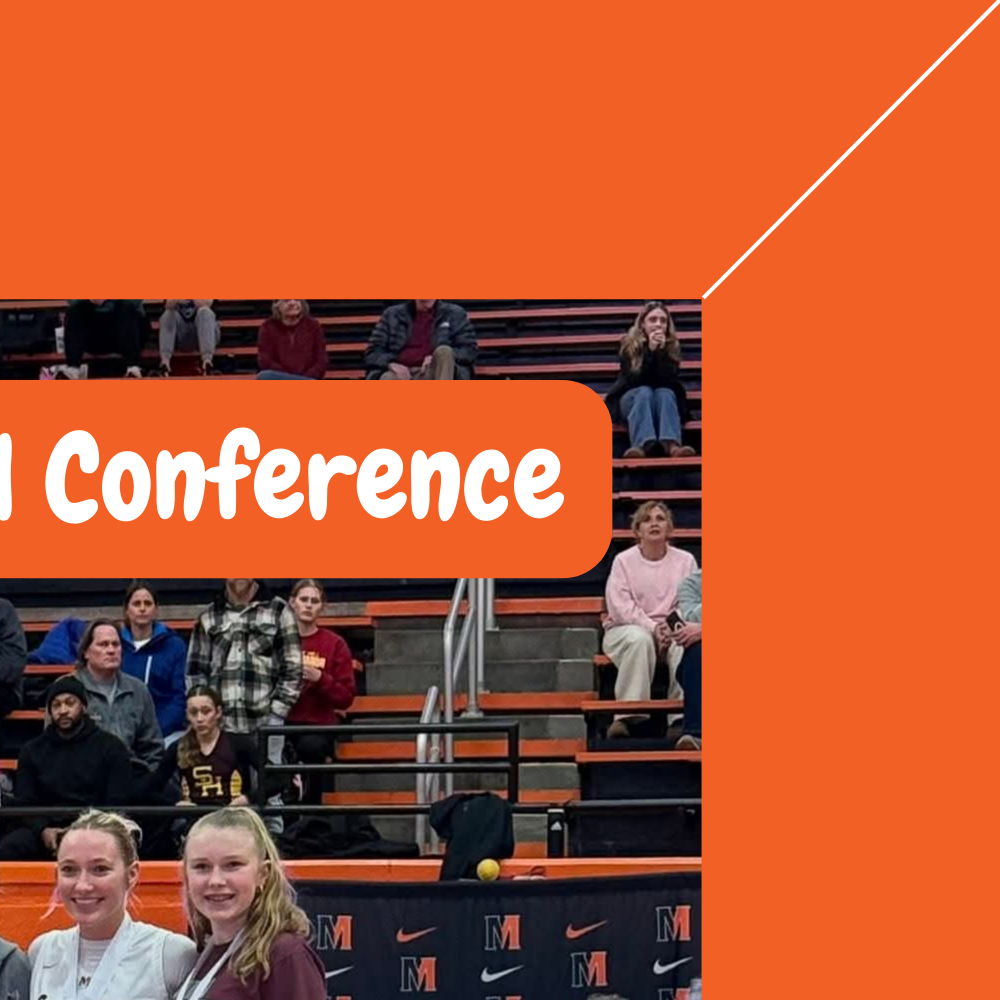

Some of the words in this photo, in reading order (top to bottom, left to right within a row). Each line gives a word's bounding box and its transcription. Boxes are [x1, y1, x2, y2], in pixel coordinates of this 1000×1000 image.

[317, 914, 352, 950] M
[484, 914, 521, 950] M
[655, 905, 691, 942] M
[400, 957, 437, 992] M
[570, 951, 608, 987] M
